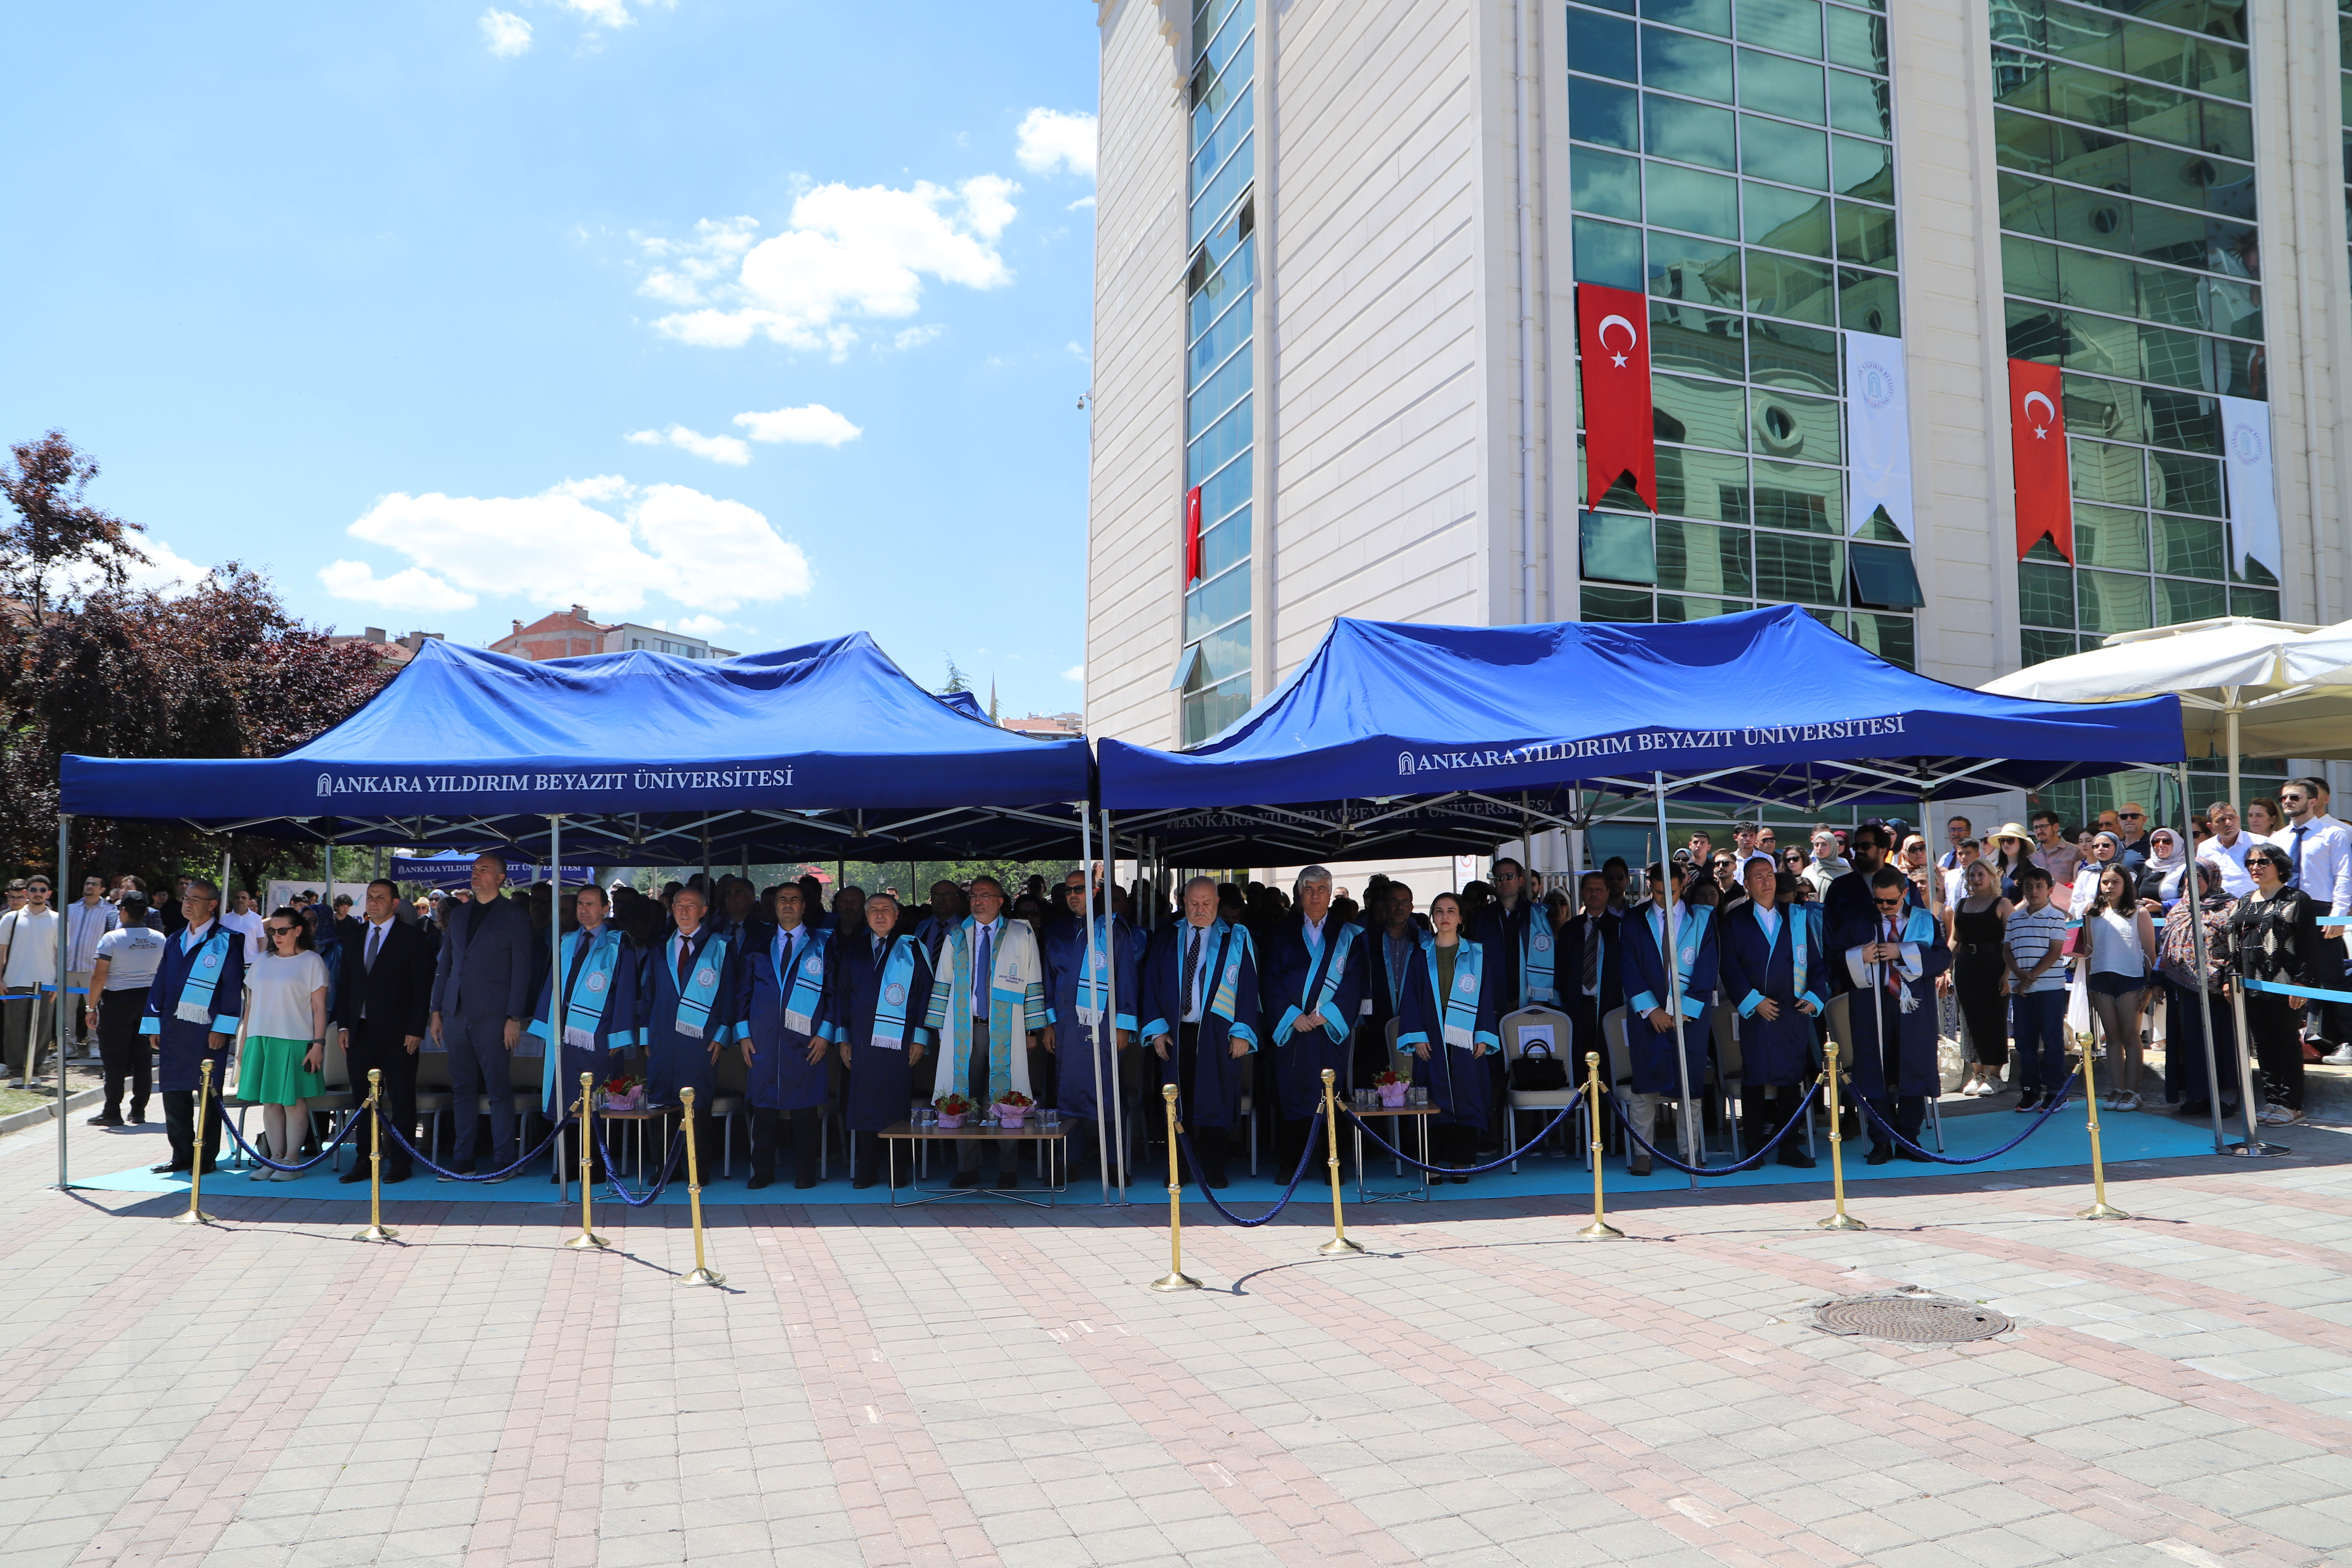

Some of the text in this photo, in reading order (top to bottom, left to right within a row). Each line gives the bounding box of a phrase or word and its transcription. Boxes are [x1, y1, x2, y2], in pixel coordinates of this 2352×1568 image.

[1862, 363, 1893, 395] YILDIRIM BEYAZIT
[1864, 395, 1890, 408] NİVERSİTESİ
[1416, 712, 1906, 771] ANKARA YILDIRIM BEYAZIT ÜNİVERSİTESİ
[332, 764, 794, 793] ANKARA YILDIRIM BEYAZIT ÜNİVERSİTESİ
[1180, 813, 1255, 828] ANKARA
